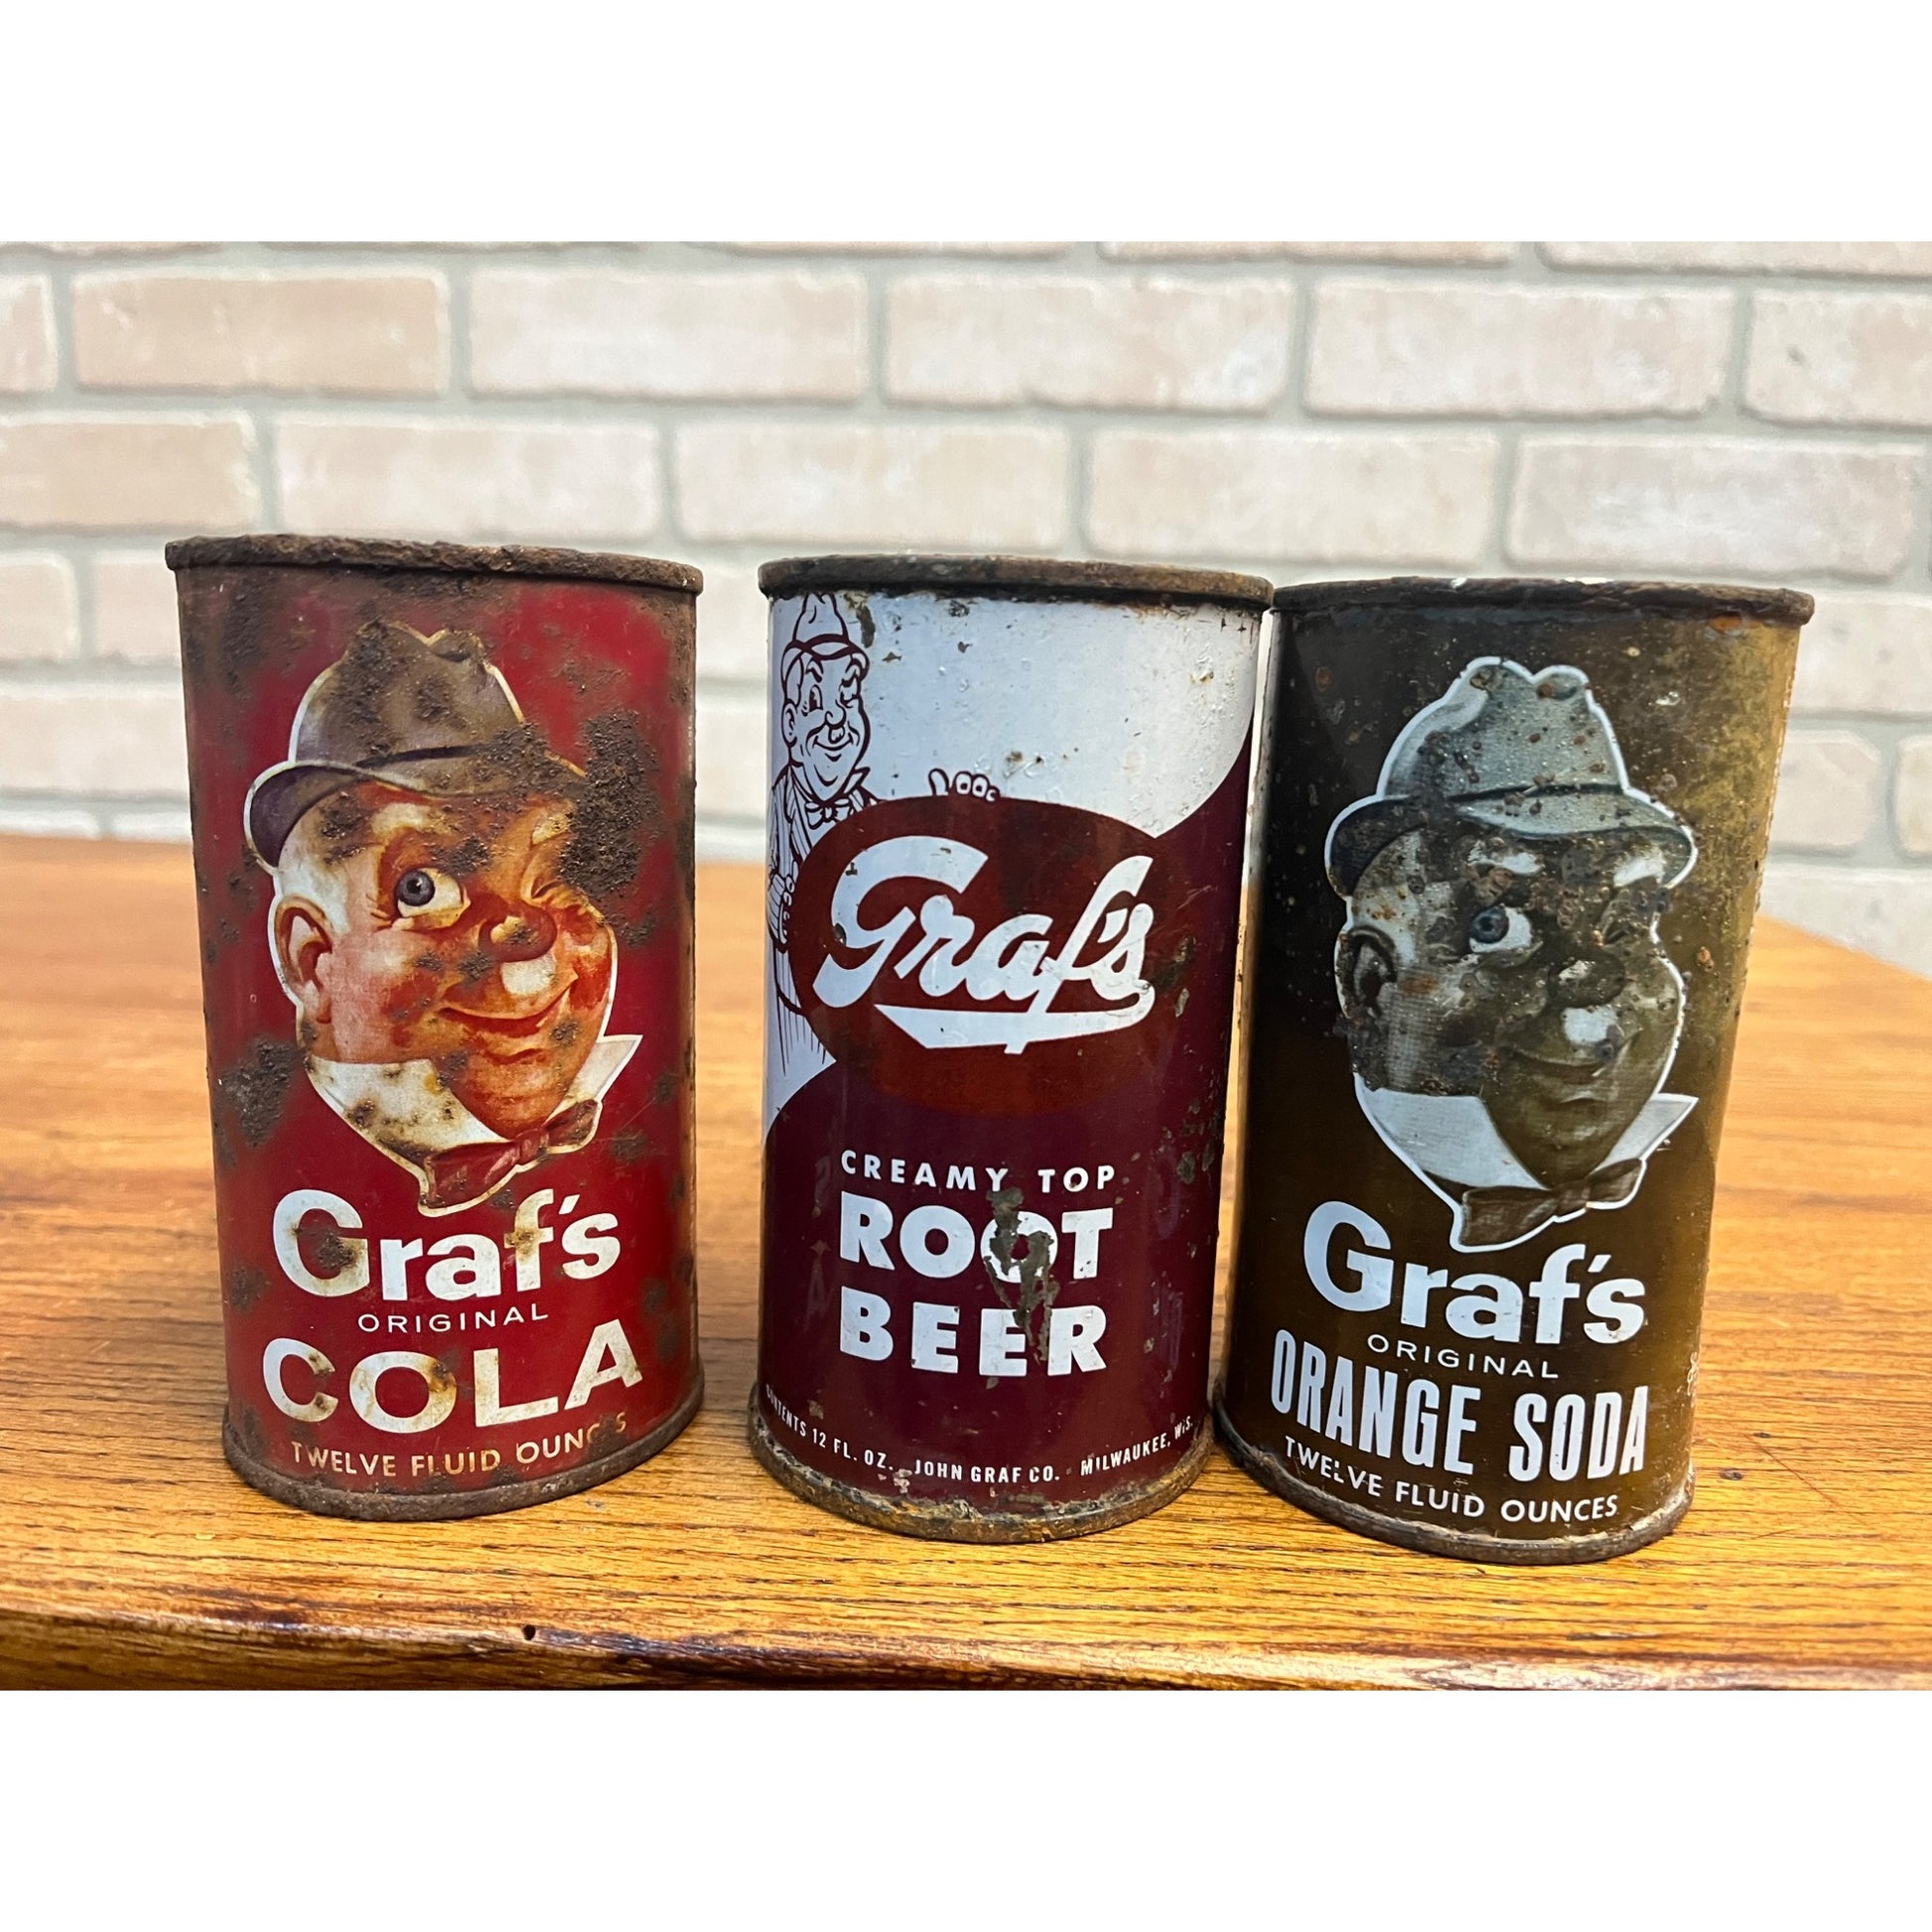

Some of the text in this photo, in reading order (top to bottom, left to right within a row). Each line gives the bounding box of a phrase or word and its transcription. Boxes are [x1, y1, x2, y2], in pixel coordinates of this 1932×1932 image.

[813, 835, 1156, 1054] Graf's
[840, 1150, 1115, 1193] CREAMY TOP
[272, 1188, 621, 1302] Graf's
[840, 1191, 1114, 1283] ROOT
[1303, 1200, 1646, 1344] Graf's
[357, 1303, 549, 1333] ORIGINAL
[840, 1286, 1107, 1377] BEER
[1366, 1333, 1560, 1379] ORIGINAL
[262, 1318, 643, 1434] COLA
[1270, 1328, 1649, 1482] ORANGE SODA
[291, 1411, 626, 1477] TWELVE FLUID OUNCS
[812, 1428, 827, 1449] 12
[833, 1438, 858, 1461] FL.
[864, 1449, 894, 1470] OZ.
[914, 1458, 963, 1480] JOHN
[970, 1465, 1023, 1483] GRAF
[1029, 1464, 1060, 1483] CO.
[1080, 1433, 1172, 1476] MILWAUKEE,
[1284, 1436, 1618, 1523] TWELVE FLUID OUNCES
